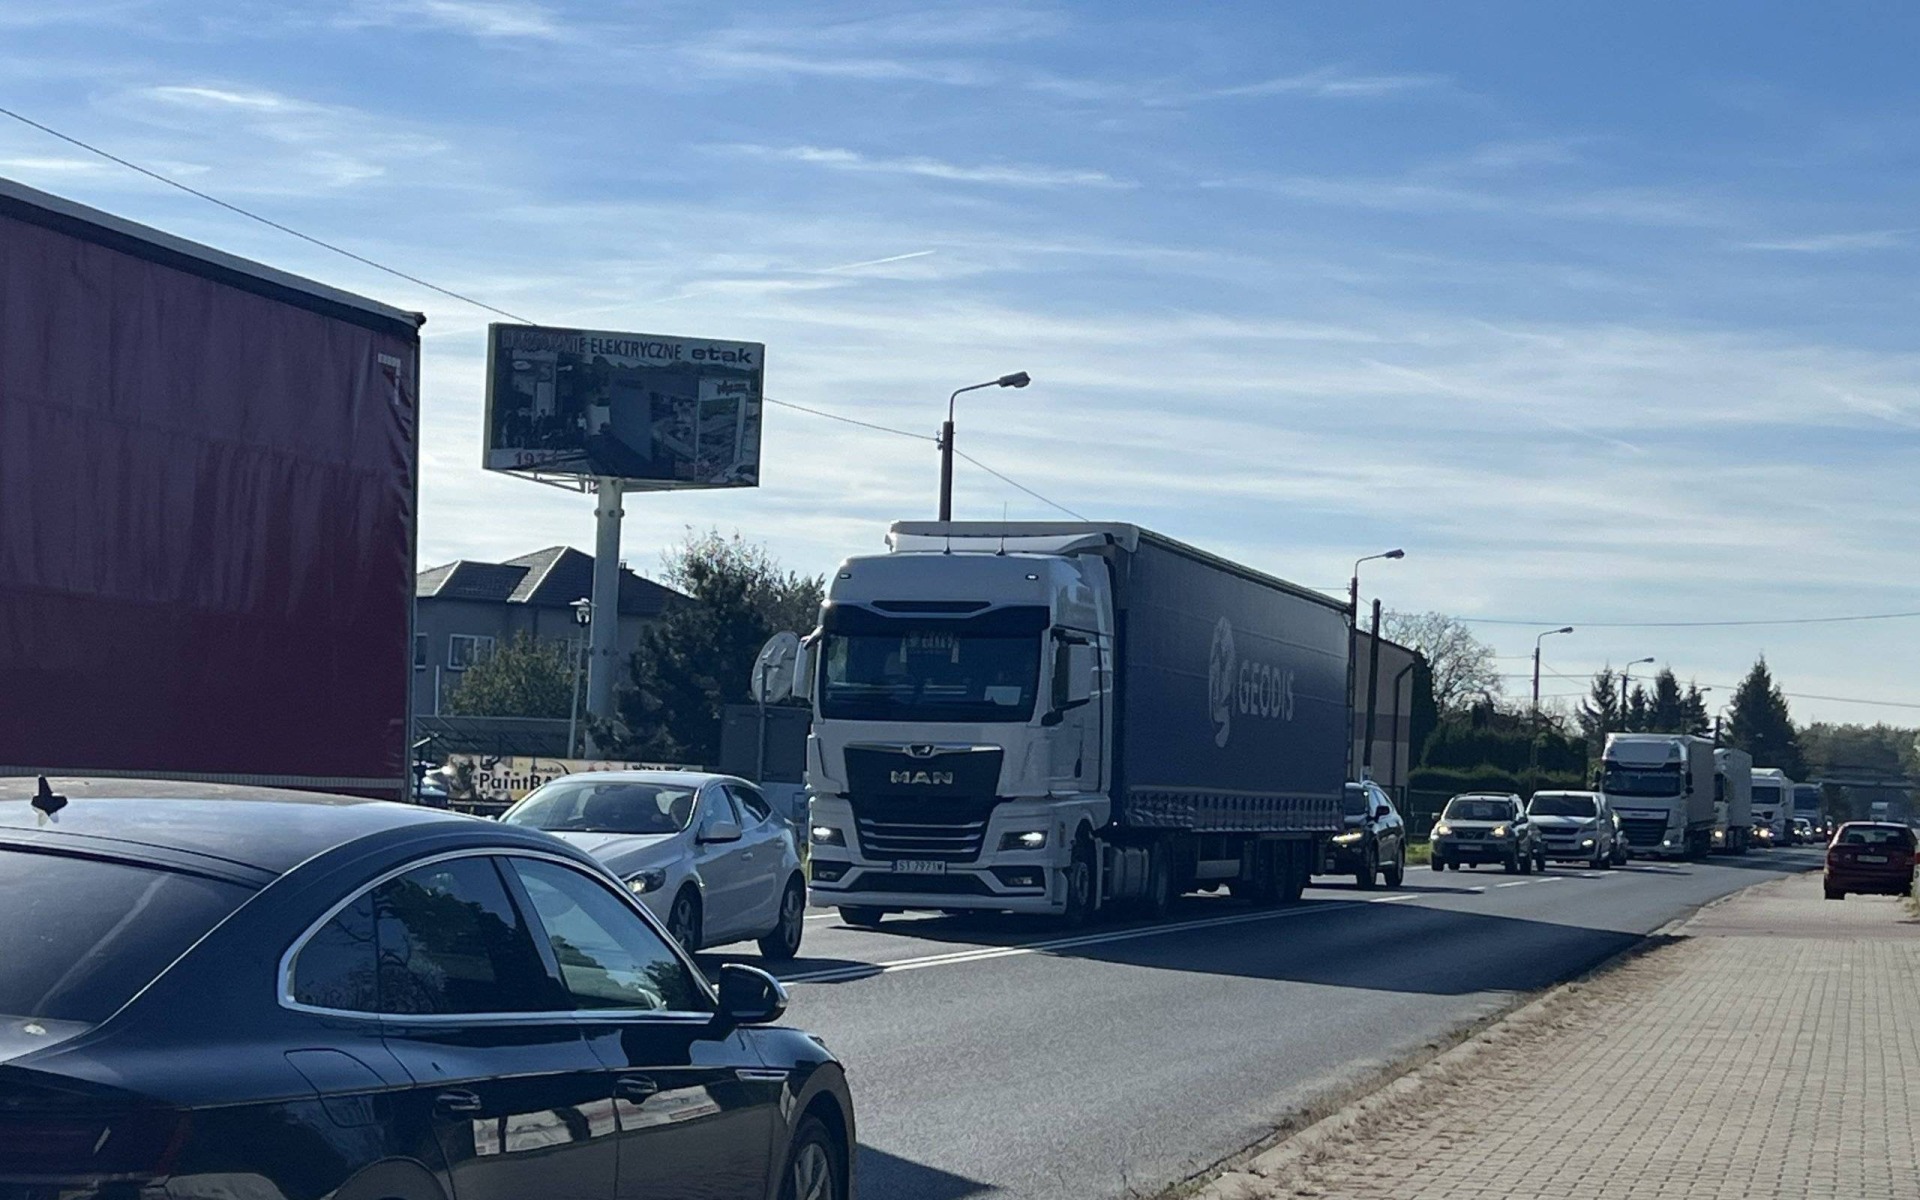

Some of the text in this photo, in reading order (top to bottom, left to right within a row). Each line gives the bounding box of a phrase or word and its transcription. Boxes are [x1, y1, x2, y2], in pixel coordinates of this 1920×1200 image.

[590, 338, 682, 359] ELEKTRYCZNE
[691, 347, 752, 364] etak
[1239, 660, 1294, 721] GEODIS
[890, 770, 953, 784] MAN
